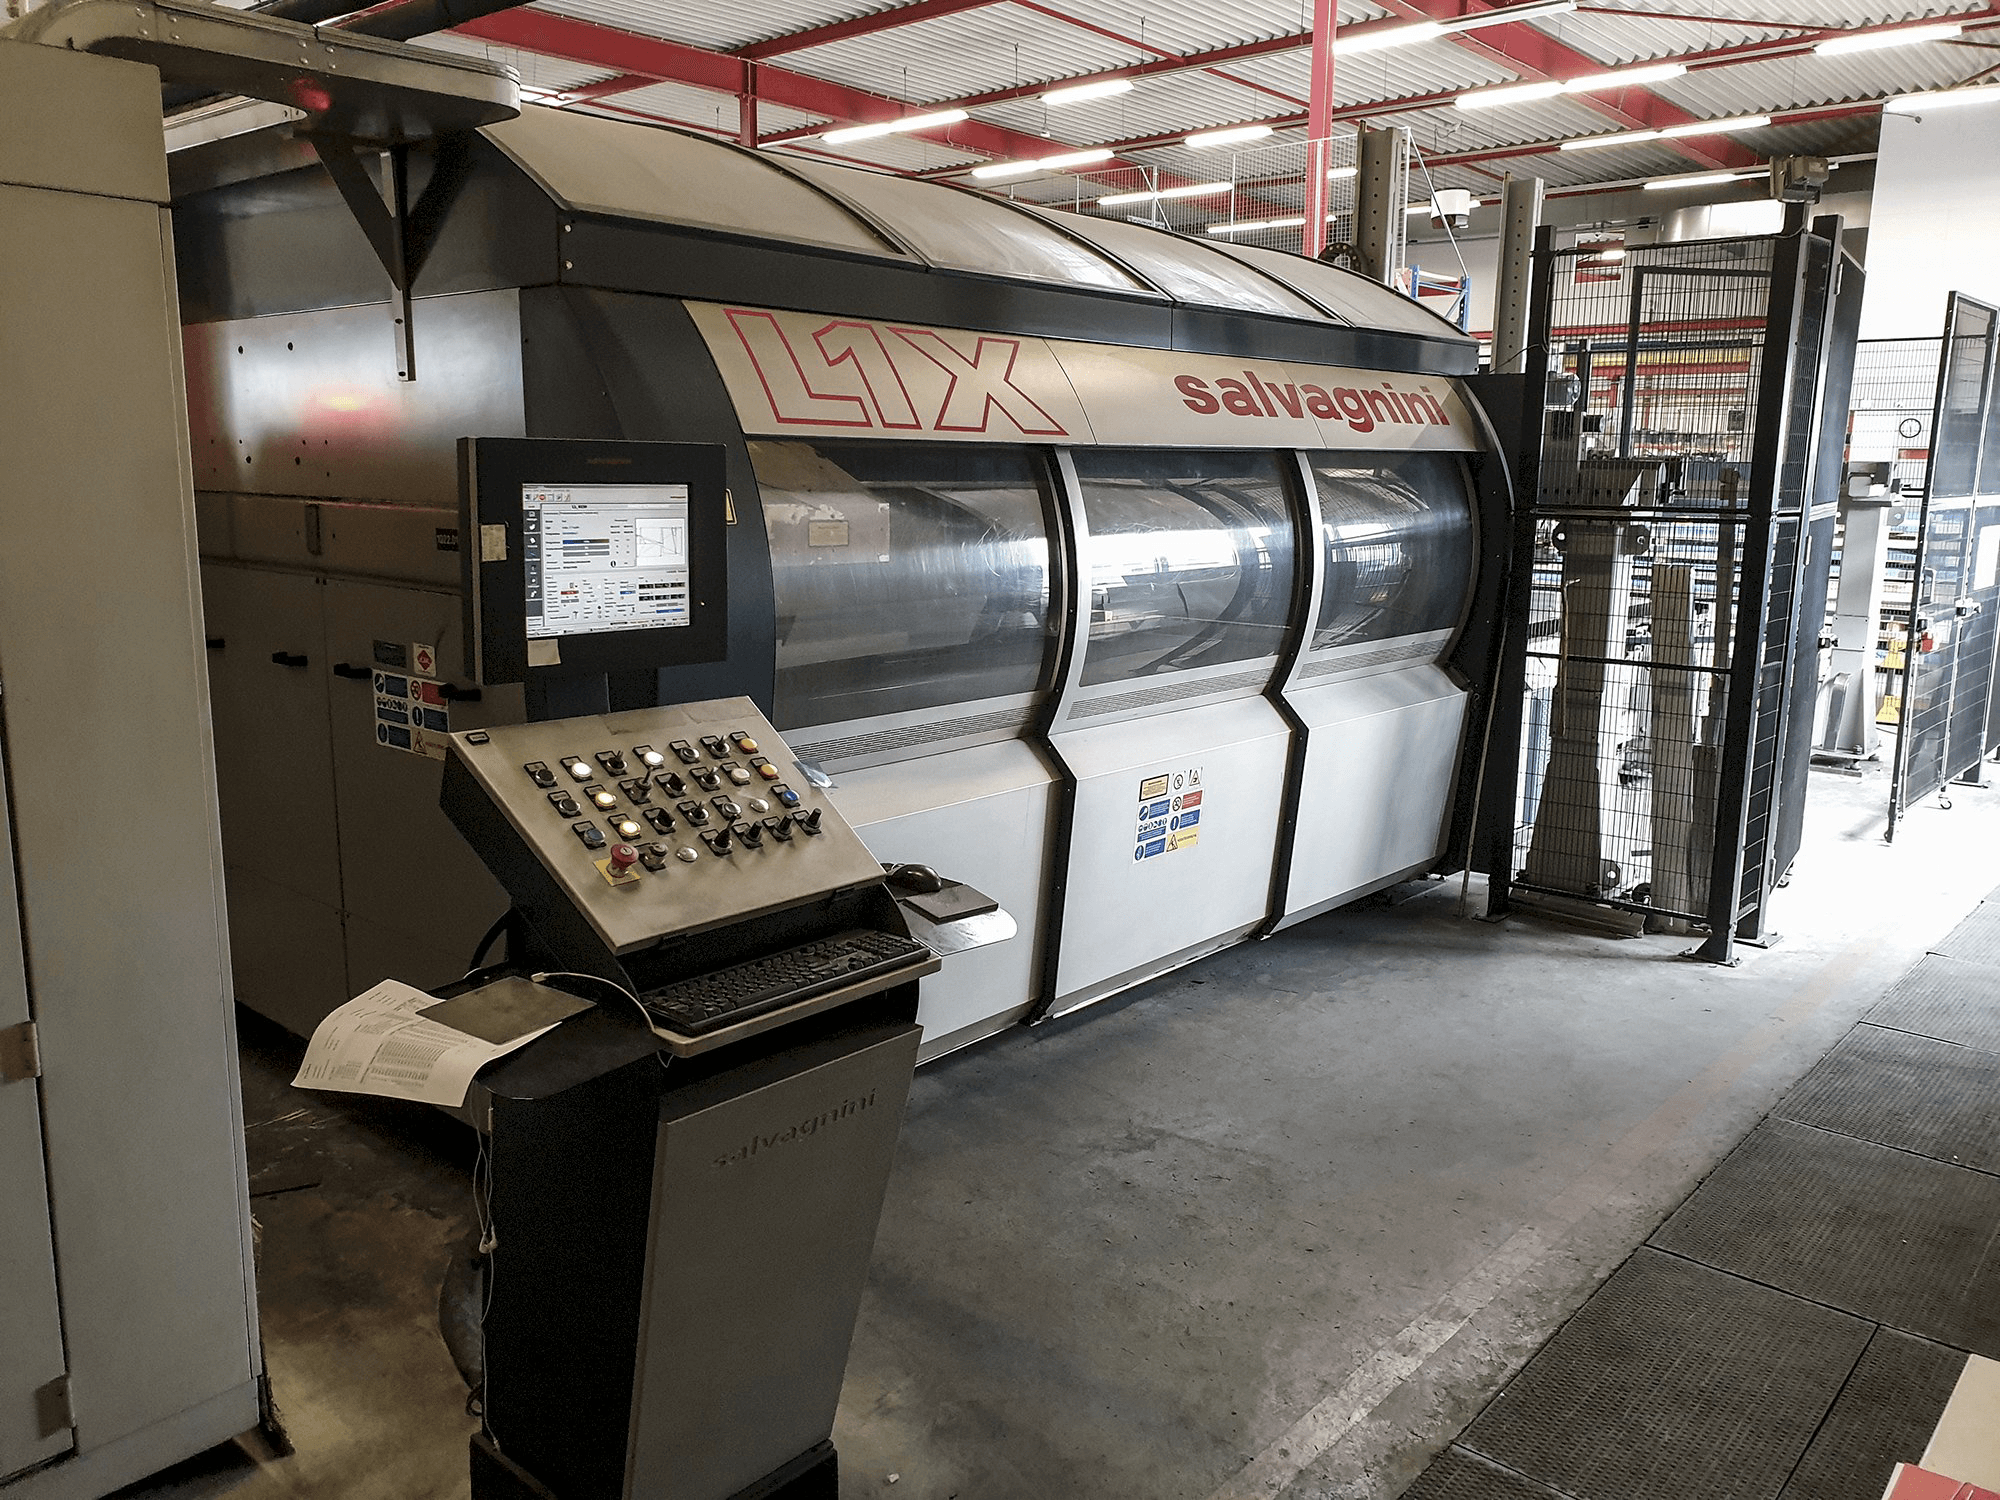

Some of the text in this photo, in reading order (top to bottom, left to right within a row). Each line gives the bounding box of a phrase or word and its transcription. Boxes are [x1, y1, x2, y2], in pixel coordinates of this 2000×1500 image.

[722, 307, 1070, 437] L1X
[1173, 370, 1451, 433] salvagnini
[711, 1087, 877, 1168] salvagnini
